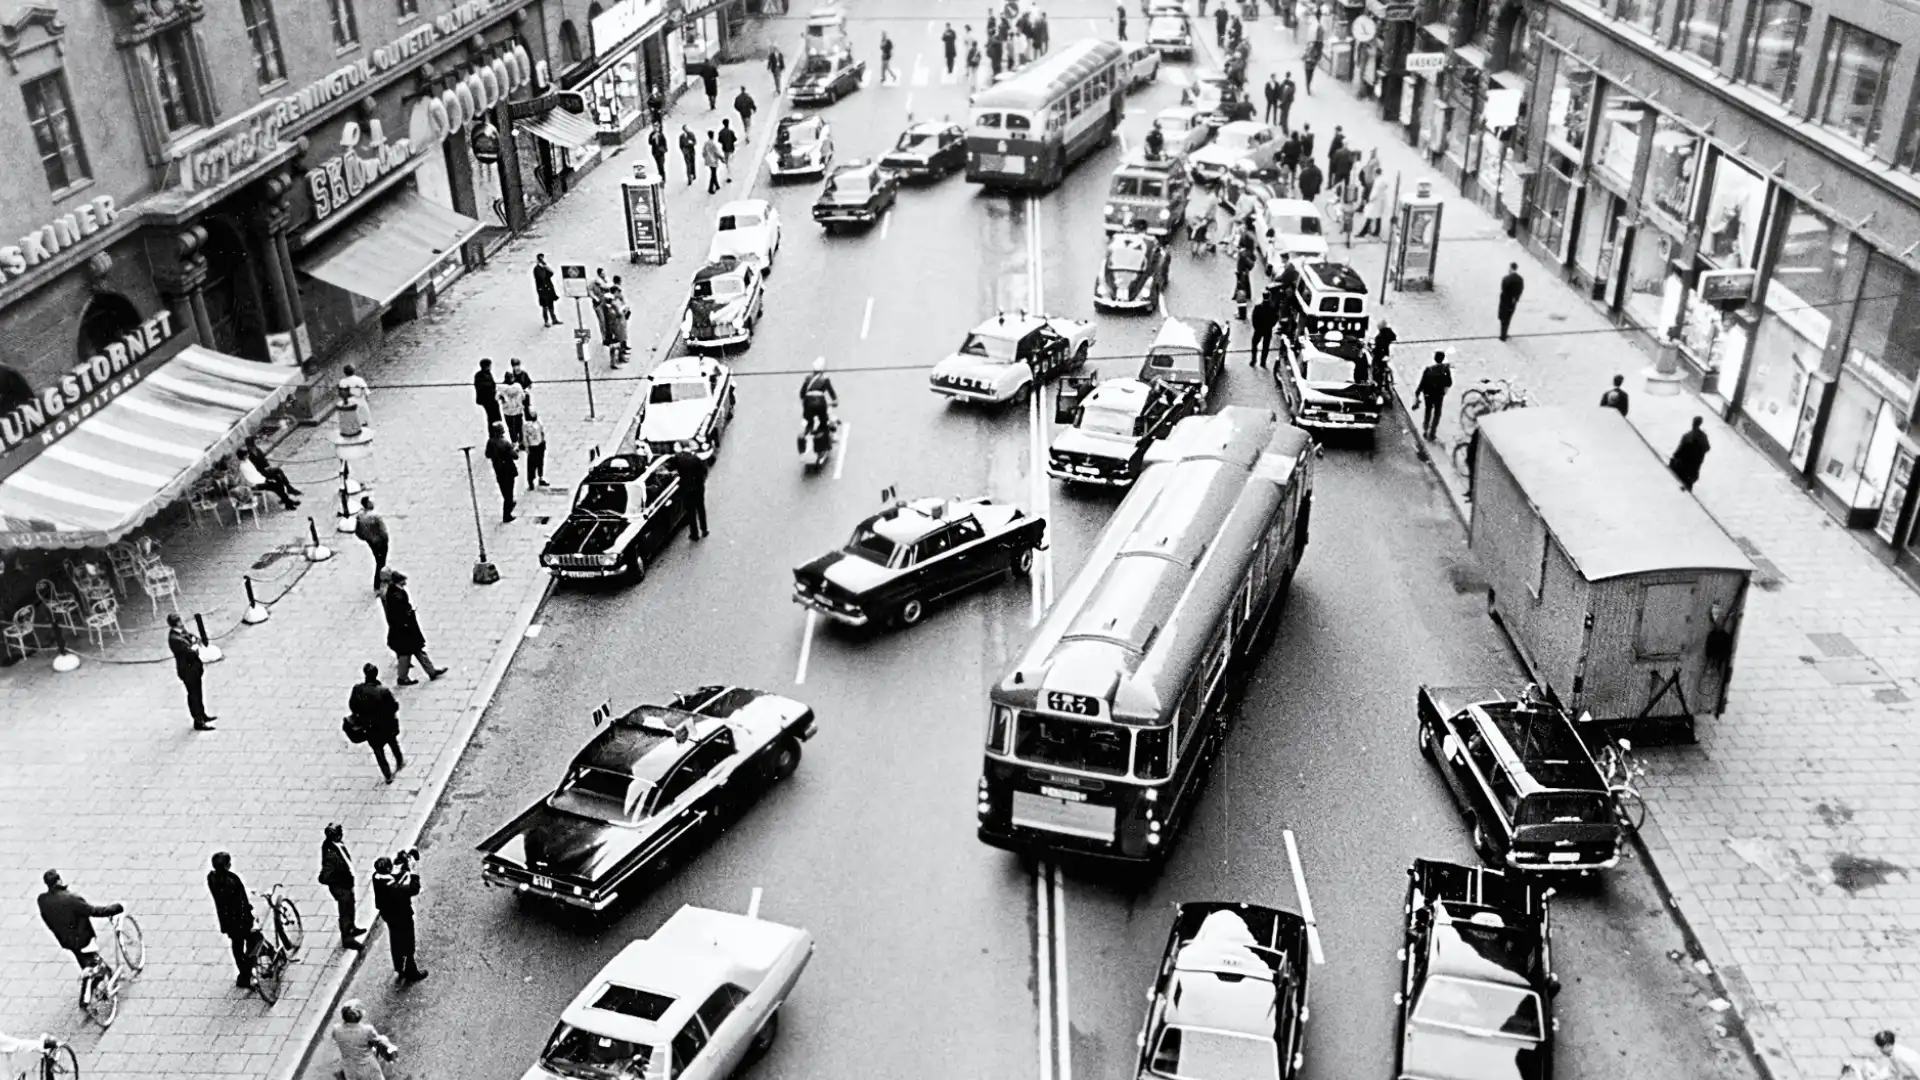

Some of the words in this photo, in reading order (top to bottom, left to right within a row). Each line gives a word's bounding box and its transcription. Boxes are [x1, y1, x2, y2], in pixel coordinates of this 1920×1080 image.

[0, 195, 118, 283] SKINER
[0, 310, 172, 451] UNGSTORNET
[41, 368, 140, 445] KONDITORI
